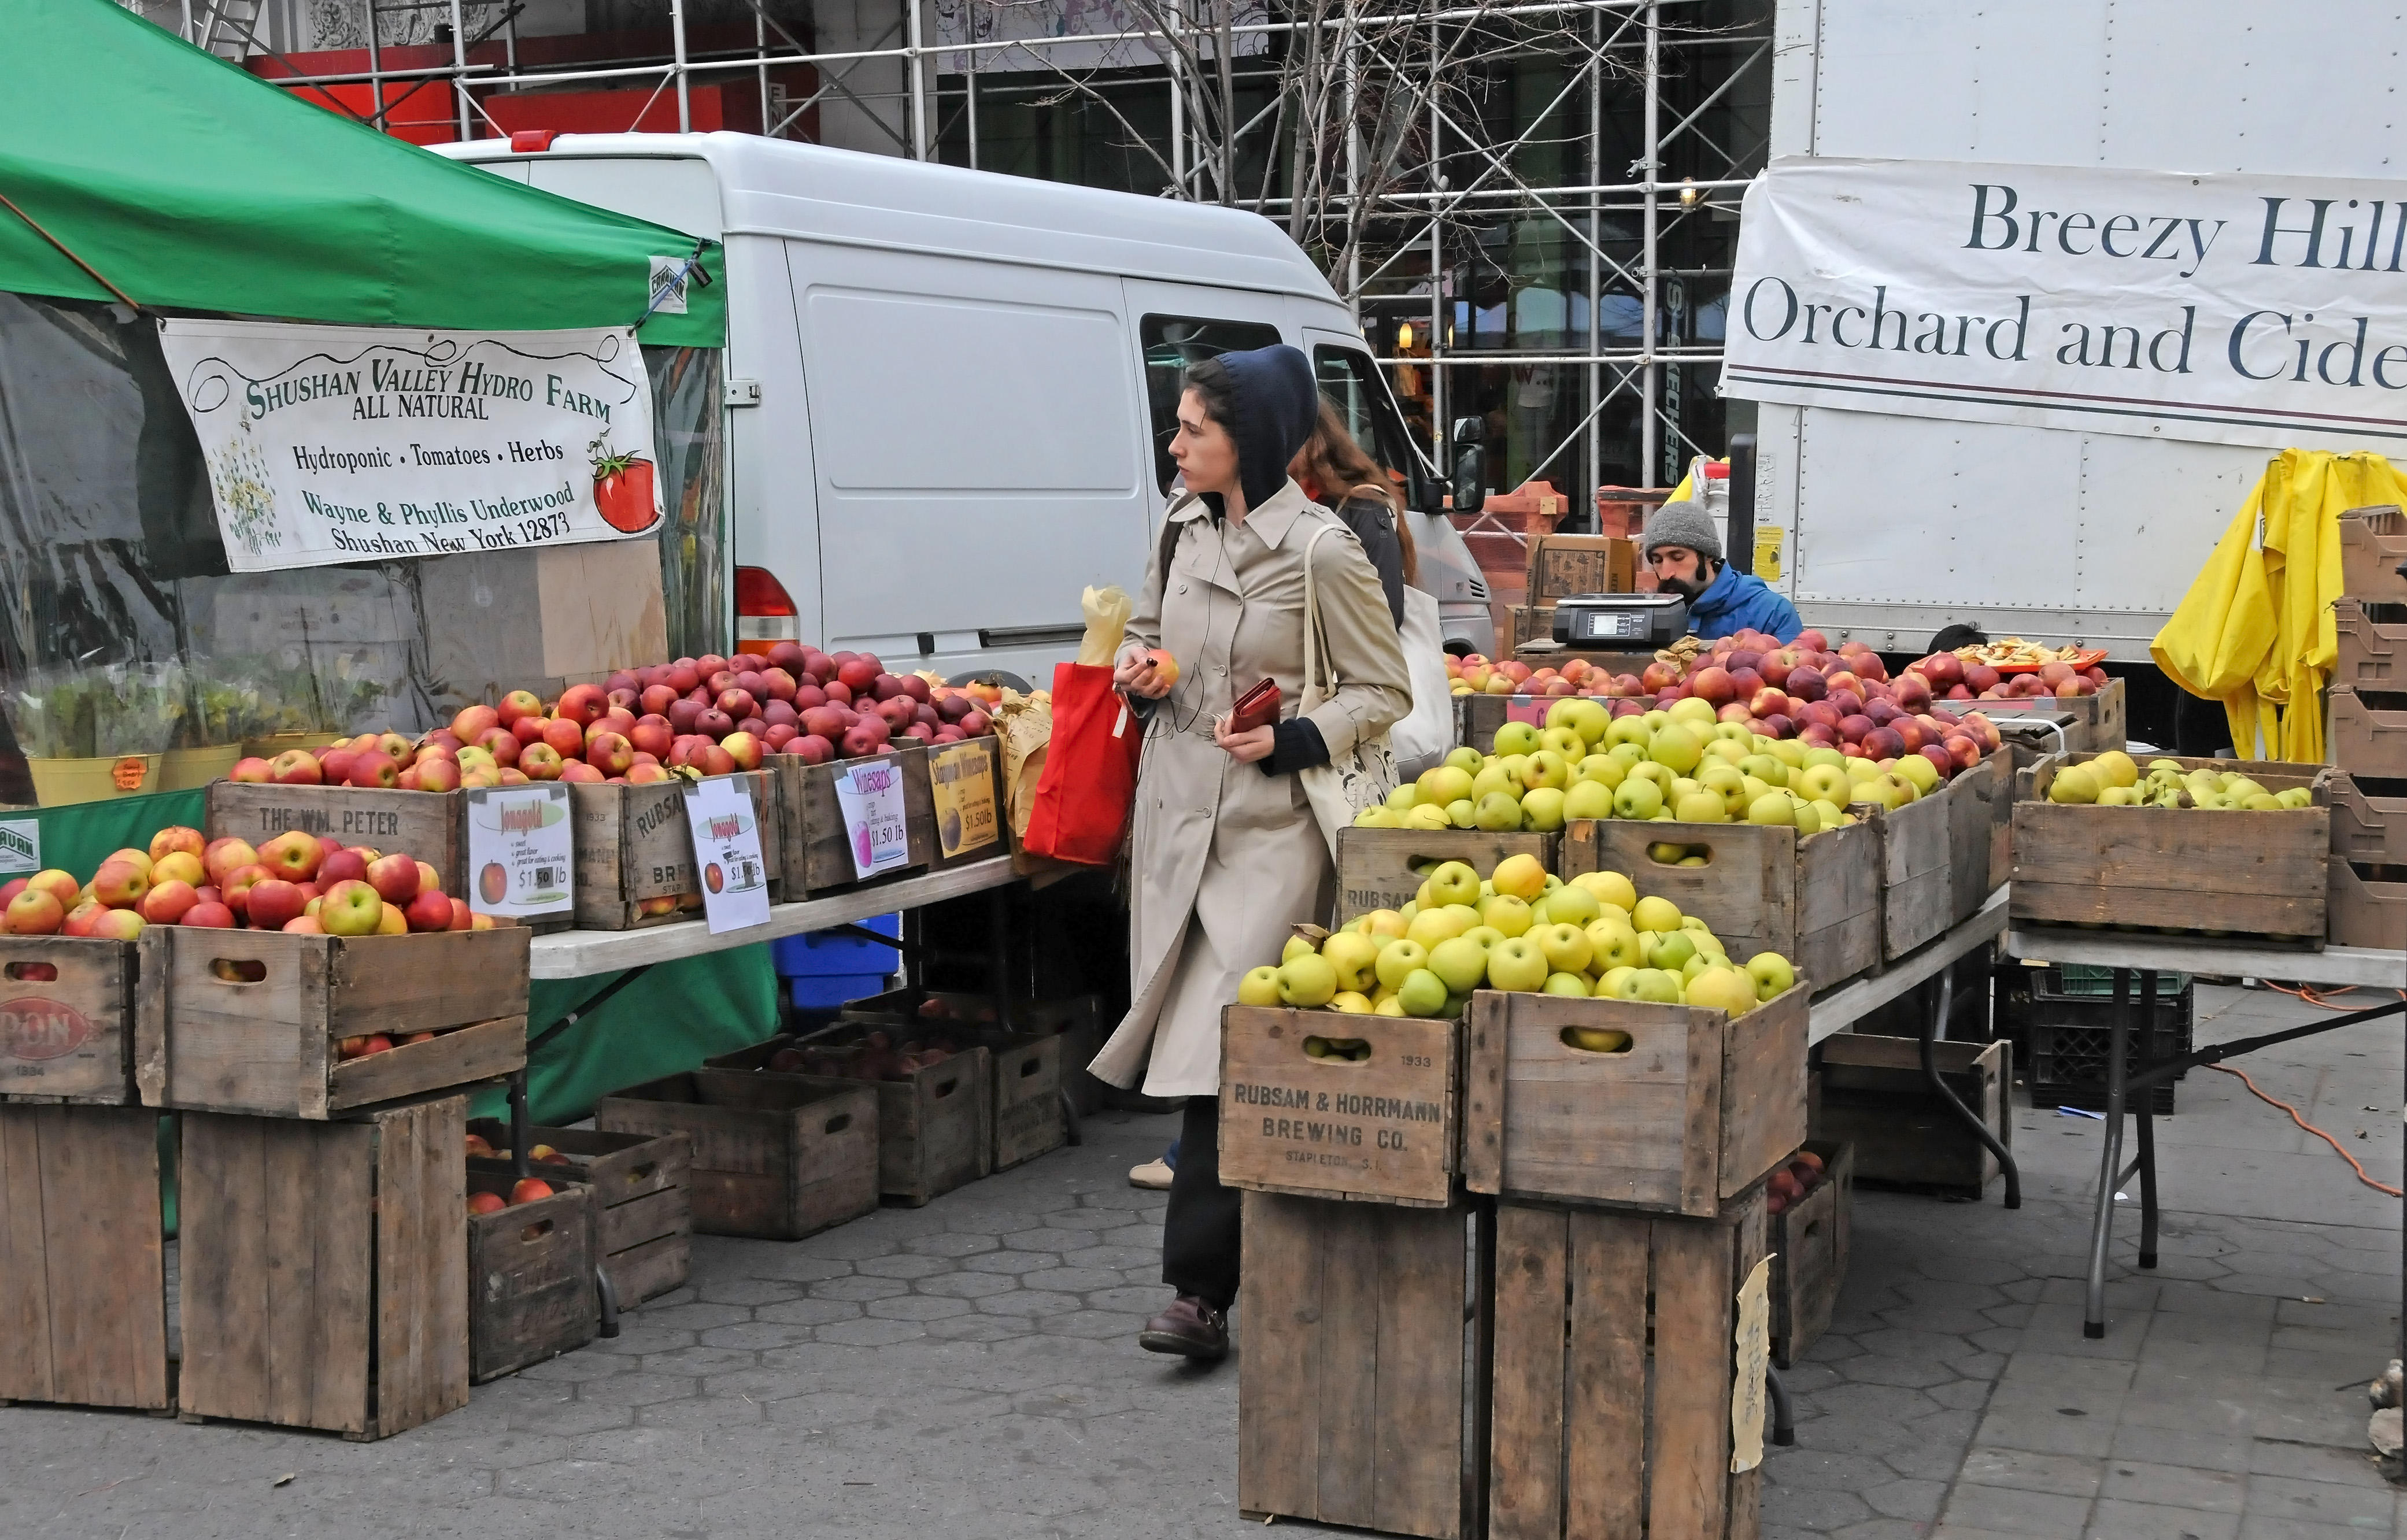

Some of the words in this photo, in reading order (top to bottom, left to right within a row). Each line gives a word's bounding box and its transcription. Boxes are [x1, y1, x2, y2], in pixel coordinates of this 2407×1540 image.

[1960, 184, 2229, 278] Breezy
[2248, 197, 2407, 272] Hill
[1743, 276, 2031, 361] Orchard
[2056, 305, 2196, 374] and
[2228, 310, 2407, 390] Cide
[246, 371, 361, 420] SHUSHAN
[372, 358, 453, 393] VALLEY
[457, 361, 533, 402] HYDRO
[546, 373, 611, 424] FARM
[353, 395, 390, 420] ALL
[398, 395, 489, 420] NATURAL
[1665, 331, 1681, 486] SKECHERS
[293, 445, 393, 475] Hydroponic
[409, 443, 490, 466] Tomatoes
[507, 439, 564, 463] Herbs
[301, 489, 371, 525] Wayne
[376, 502, 395, 525] &
[399, 501, 468, 528] Phyllis
[469, 480, 575, 521] Underwood
[331, 527, 418, 553] Shushan
[419, 531, 466, 553] New
[468, 525, 513, 549] York
[517, 511, 571, 543] 12873
[852, 769, 891, 797] Winesaps
[260, 807, 292, 831] THE
[300, 809, 335, 833] WM.
[343, 810, 398, 835] PETER
[555, 866, 567, 884] lb
[1400, 1055, 1432, 1068] 1933
[1234, 1083, 1310, 1110] RUBSAM
[1315, 1091, 1329, 1112] &
[1336, 1093, 1440, 1123] HORRMANN
[1262, 1117, 1362, 1146] BREWING
[1377, 1129, 1408, 1152] CO.
